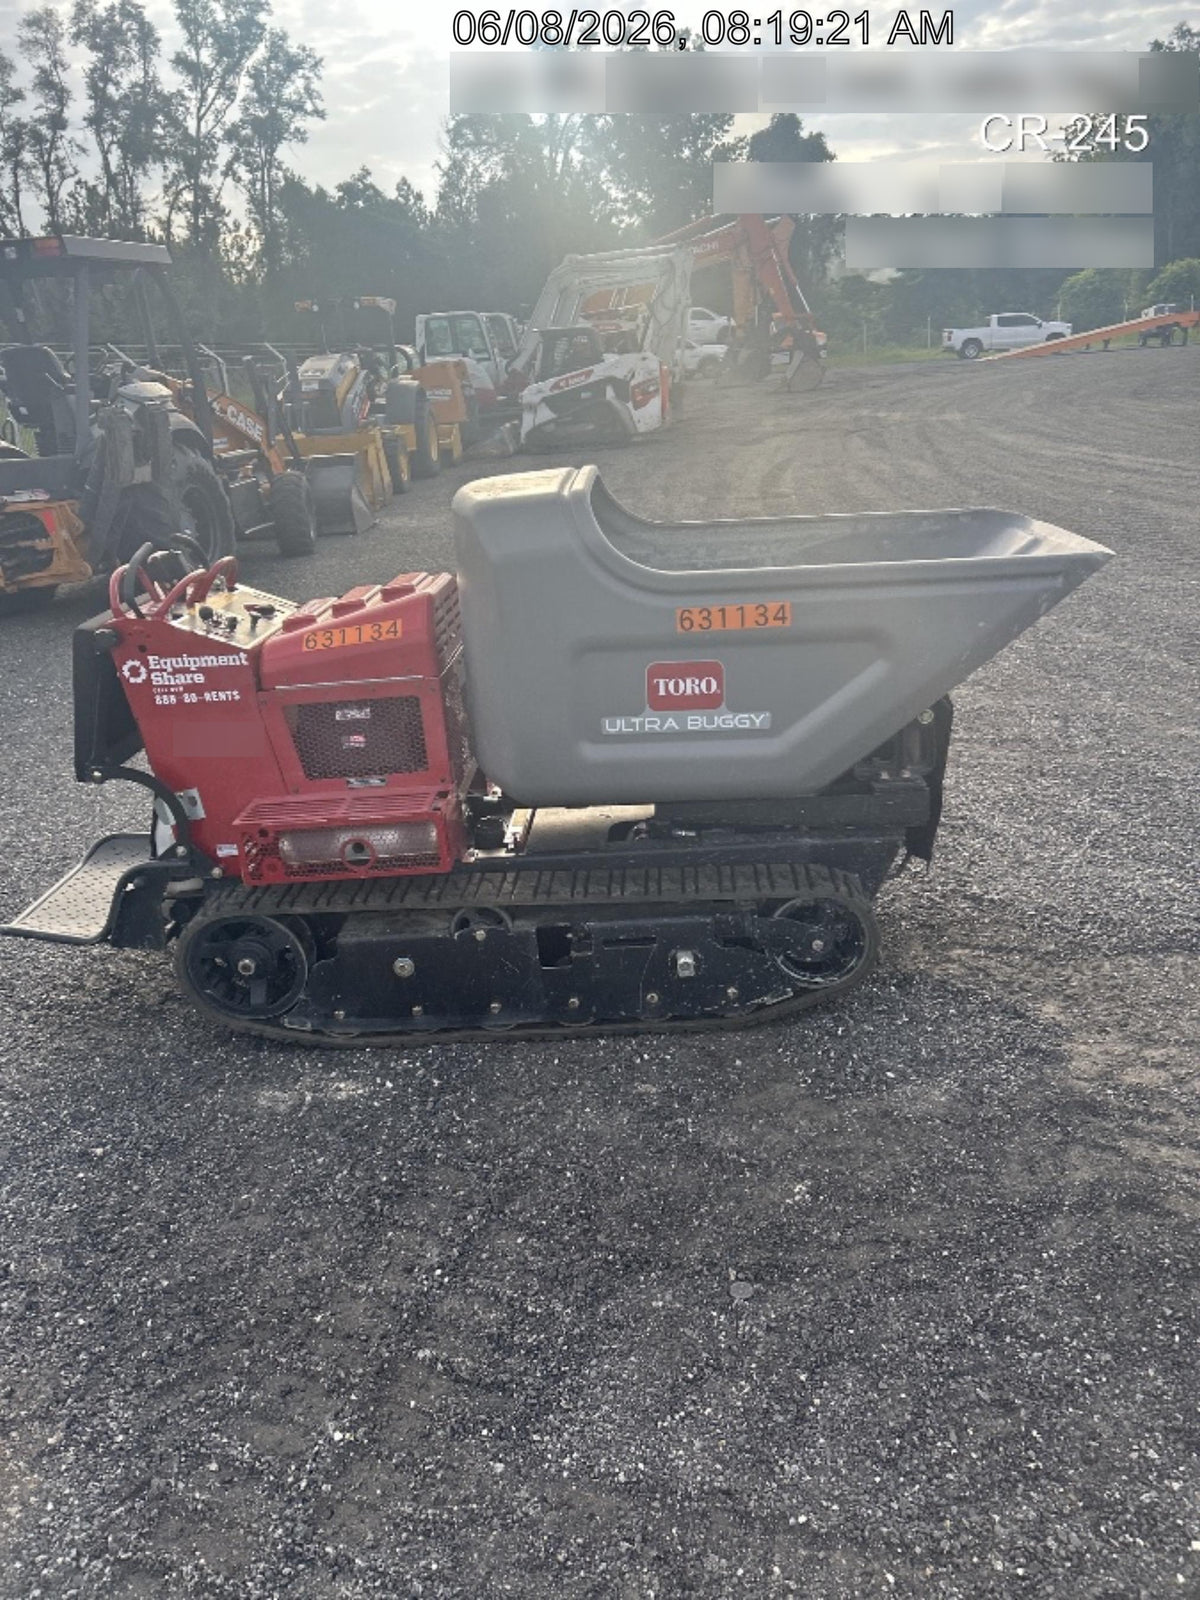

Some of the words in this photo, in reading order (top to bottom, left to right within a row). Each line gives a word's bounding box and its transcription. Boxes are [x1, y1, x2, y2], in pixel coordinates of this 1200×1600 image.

[227, 404, 263, 441] CASE
[679, 604, 788, 631] 631134
[304, 620, 399, 650] 631134
[147, 652, 249, 672] Equipment
[151, 671, 205, 685] Share
[654, 676, 719, 696] TORO
[605, 717, 680, 732] ULTRA
[687, 713, 766, 731] BUGGY
